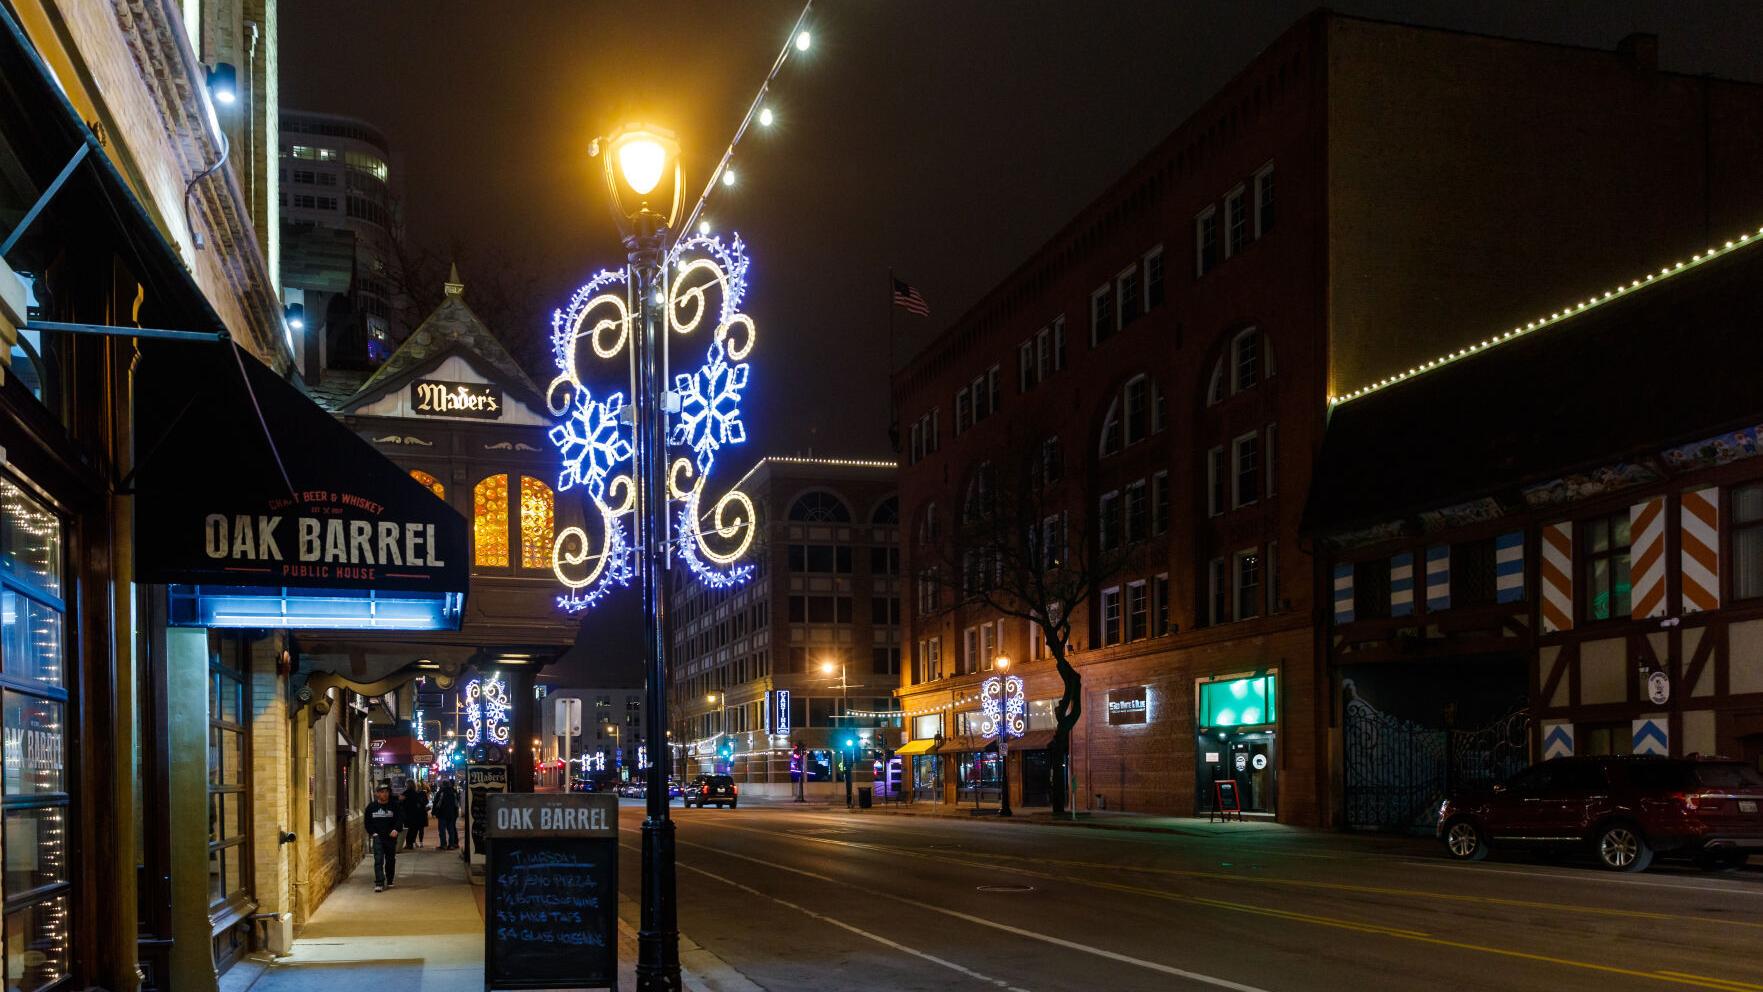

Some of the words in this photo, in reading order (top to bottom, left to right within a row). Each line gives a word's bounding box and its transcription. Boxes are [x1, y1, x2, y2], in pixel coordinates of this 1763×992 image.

[417, 383, 499, 412] Mader's
[303, 490, 327, 502] BEER
[330, 493, 337, 502] &
[341, 493, 385, 515] WHISKEY
[205, 513, 284, 560] OAK
[299, 517, 445, 567] BARREL
[282, 565, 329, 577] PUBLIC
[336, 566, 376, 580] HOUSE
[28, 730, 63, 769] BARREL
[497, 807, 534, 830] OAK
[540, 807, 610, 830] BARREL
